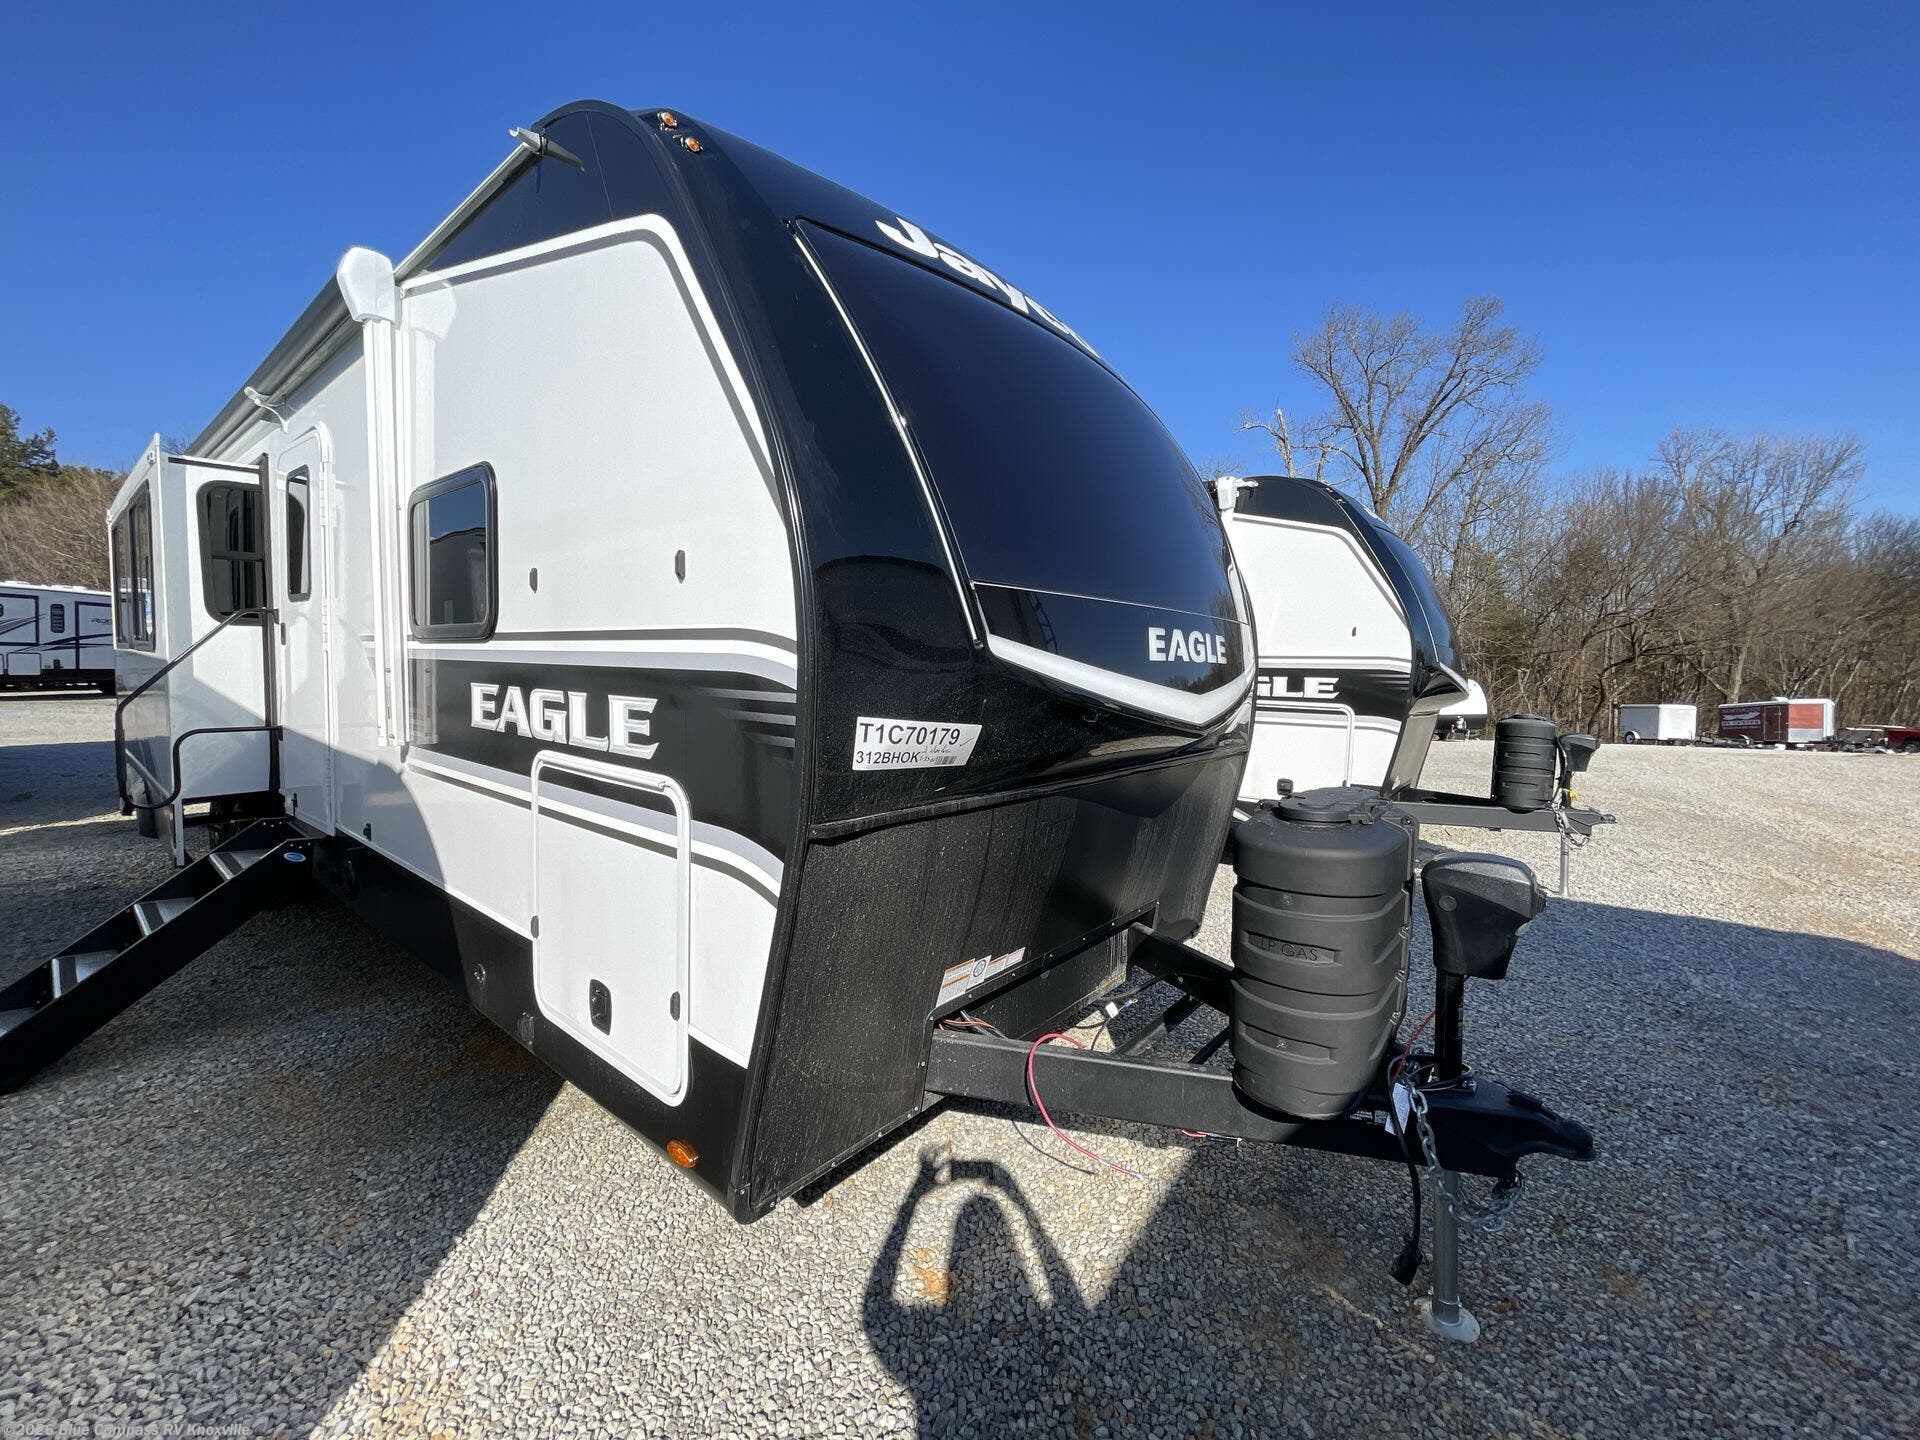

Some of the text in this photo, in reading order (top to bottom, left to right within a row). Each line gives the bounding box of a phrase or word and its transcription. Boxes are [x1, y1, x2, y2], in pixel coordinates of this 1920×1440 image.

[1148, 626, 1227, 665] EAGLE
[470, 682, 659, 760] EAGLE
[859, 722, 961, 746] T1C70179
[856, 751, 920, 764] 312BHOK
[1281, 943, 1318, 961] GAS
